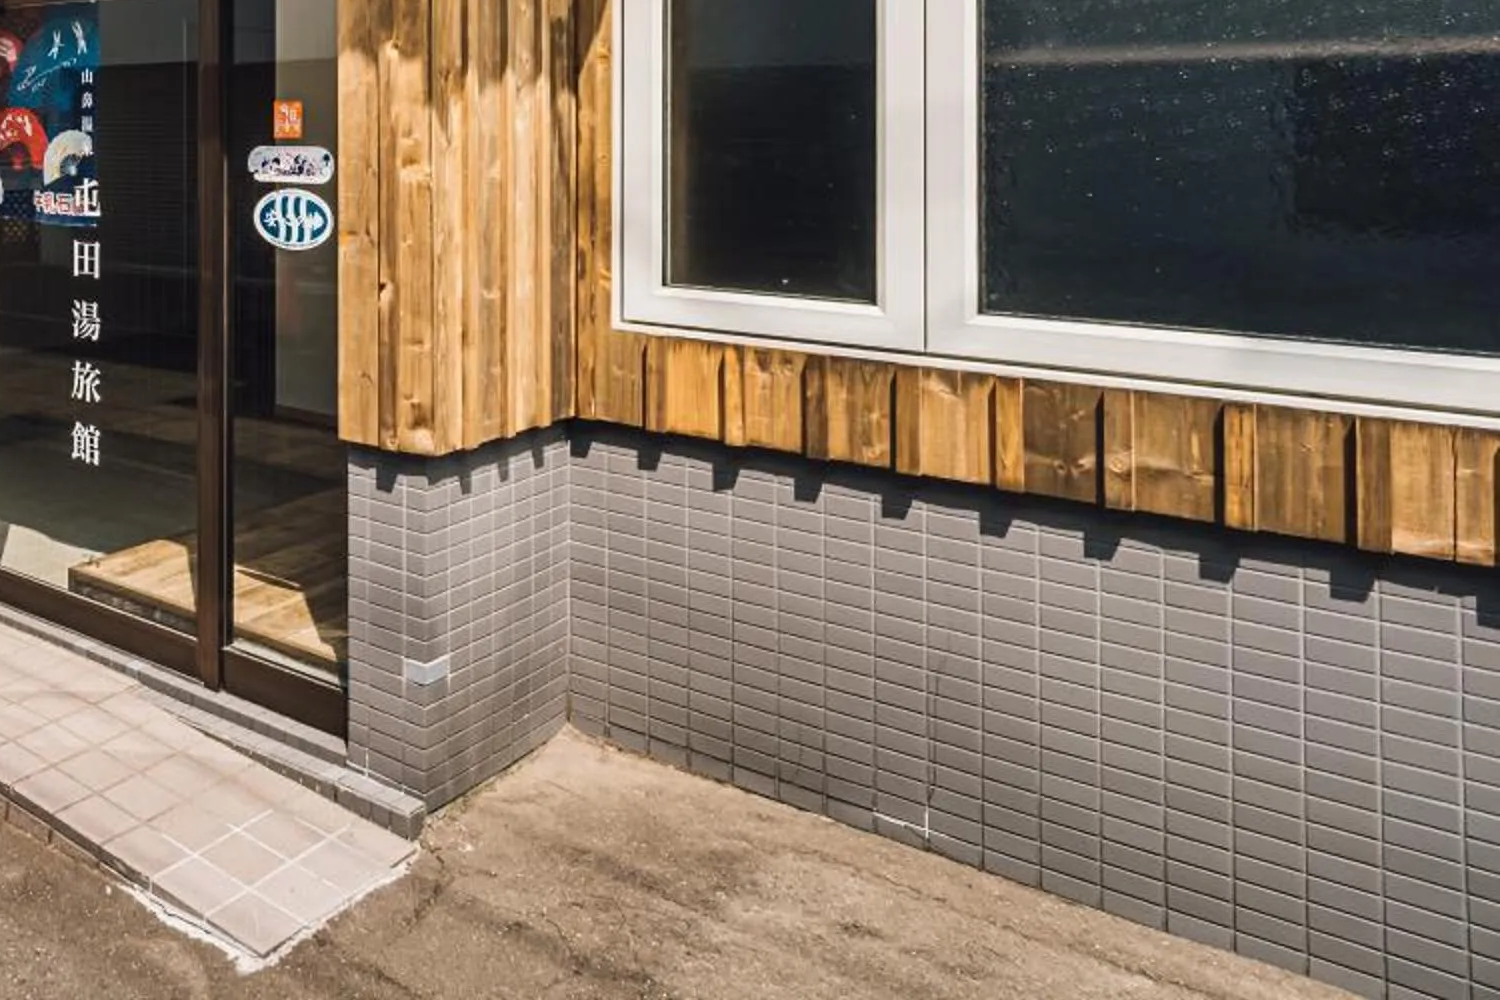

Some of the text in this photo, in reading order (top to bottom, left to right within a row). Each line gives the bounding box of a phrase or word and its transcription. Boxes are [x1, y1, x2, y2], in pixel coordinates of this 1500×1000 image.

[71, 177, 101, 467] 屯田湯旅館
